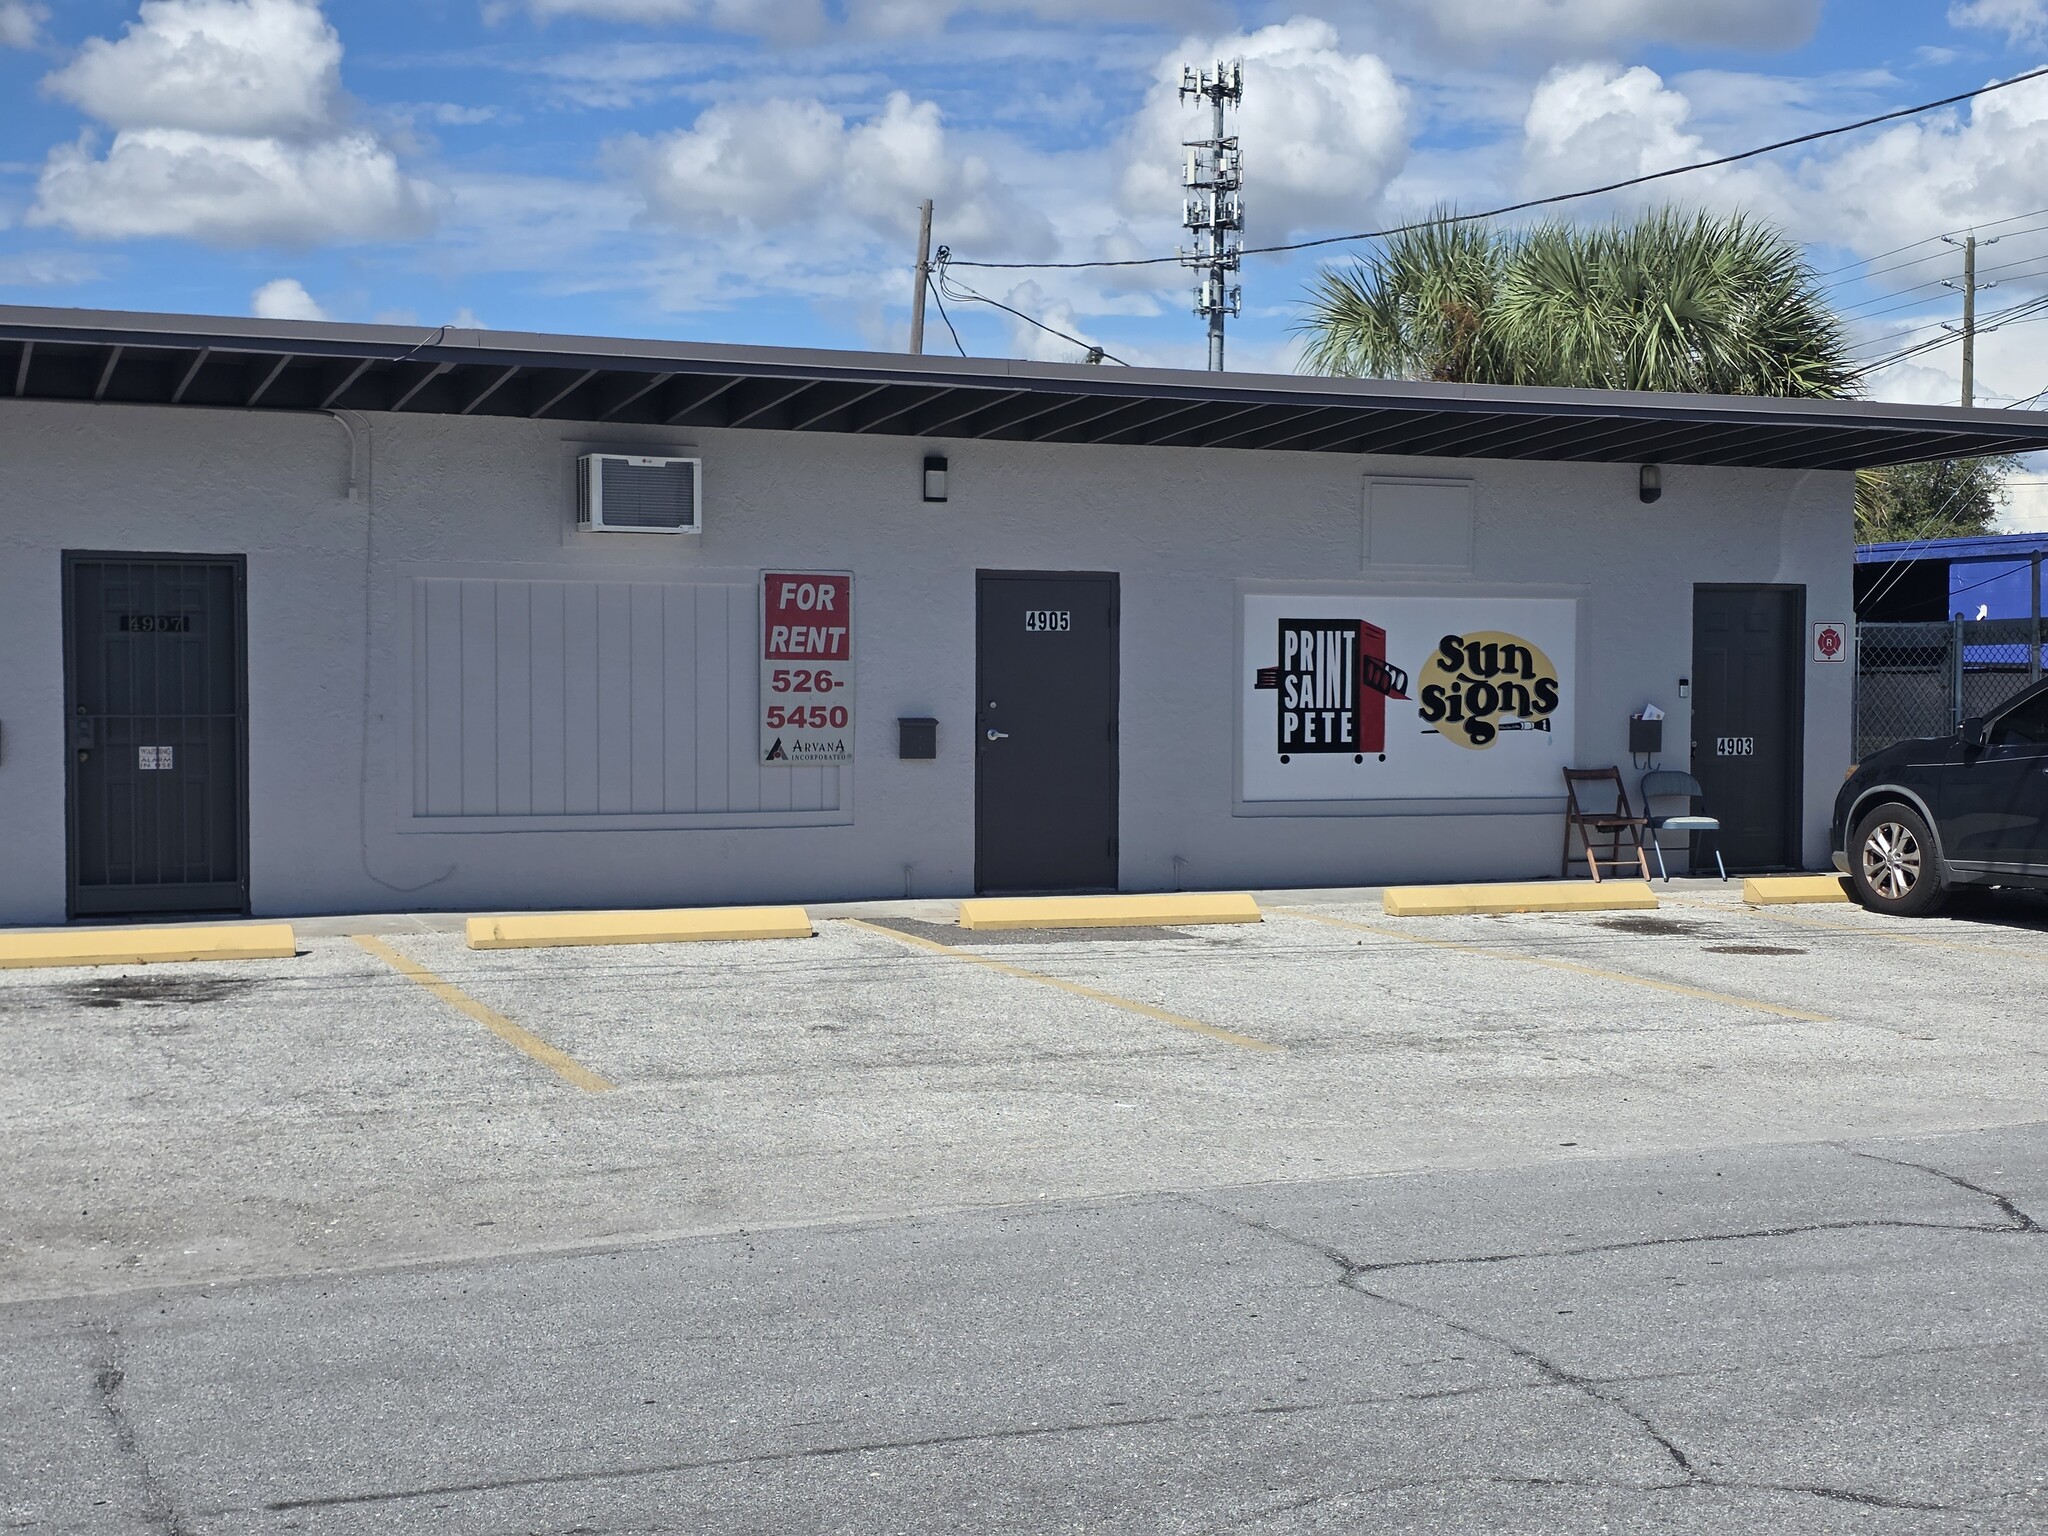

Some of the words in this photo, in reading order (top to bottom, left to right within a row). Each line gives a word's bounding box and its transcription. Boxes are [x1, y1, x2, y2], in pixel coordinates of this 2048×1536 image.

[779, 582, 836, 611] FOR
[130, 616, 183, 632] 4907
[1027, 611, 1069, 630] 4905
[769, 625, 847, 654] RENT
[1826, 638, 1833, 647] R
[1284, 630, 1356, 709] PRINT
[772, 670, 844, 693] 526-
[766, 705, 849, 729] 5450
[1283, 711, 1352, 743] PETE
[1718, 738, 1752, 755] 4903
